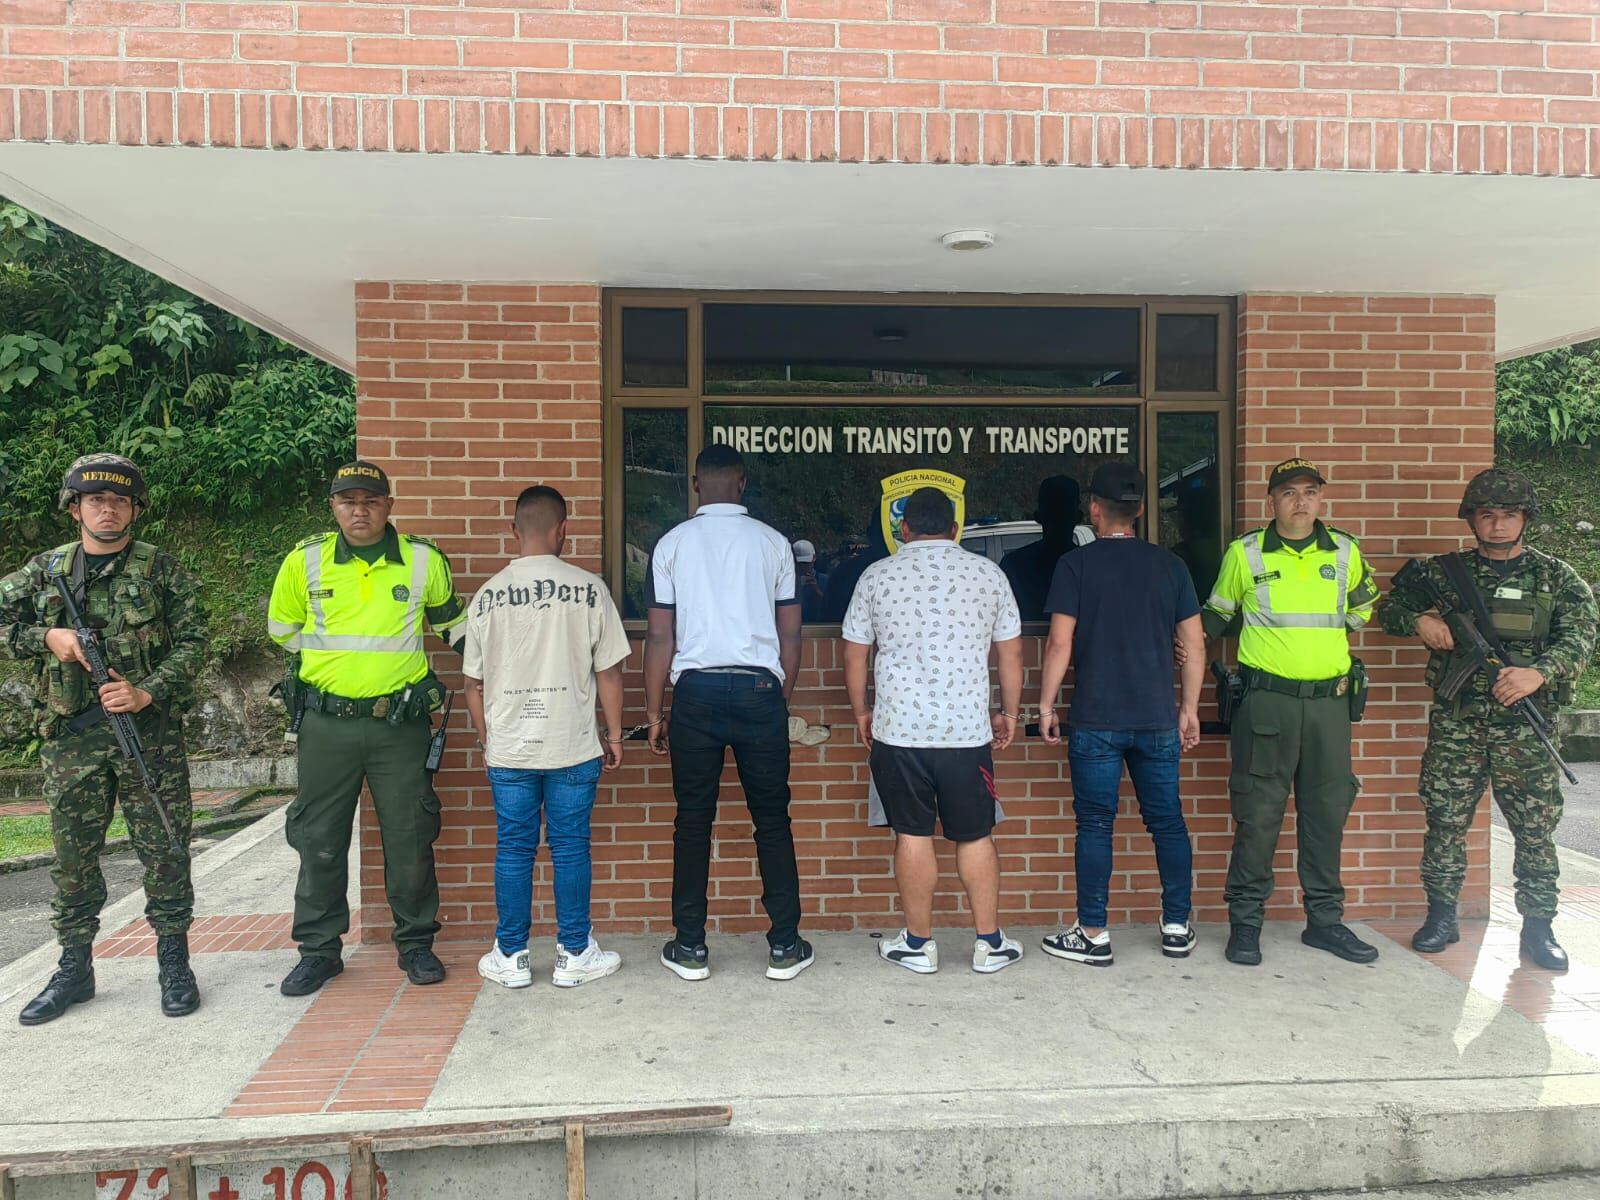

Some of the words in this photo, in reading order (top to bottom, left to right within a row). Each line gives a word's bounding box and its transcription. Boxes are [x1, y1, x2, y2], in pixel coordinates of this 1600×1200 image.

[712, 426, 833, 453] DIRECCION
[843, 427, 952, 454] TRANSITO
[958, 427, 974, 454] Y
[985, 427, 1129, 454] TRANSPORTE
[82, 471, 132, 487] METEORO
[337, 466, 381, 480] POLICIA
[919, 473, 957, 487] NACIONAL
[532, 579, 598, 609] York
